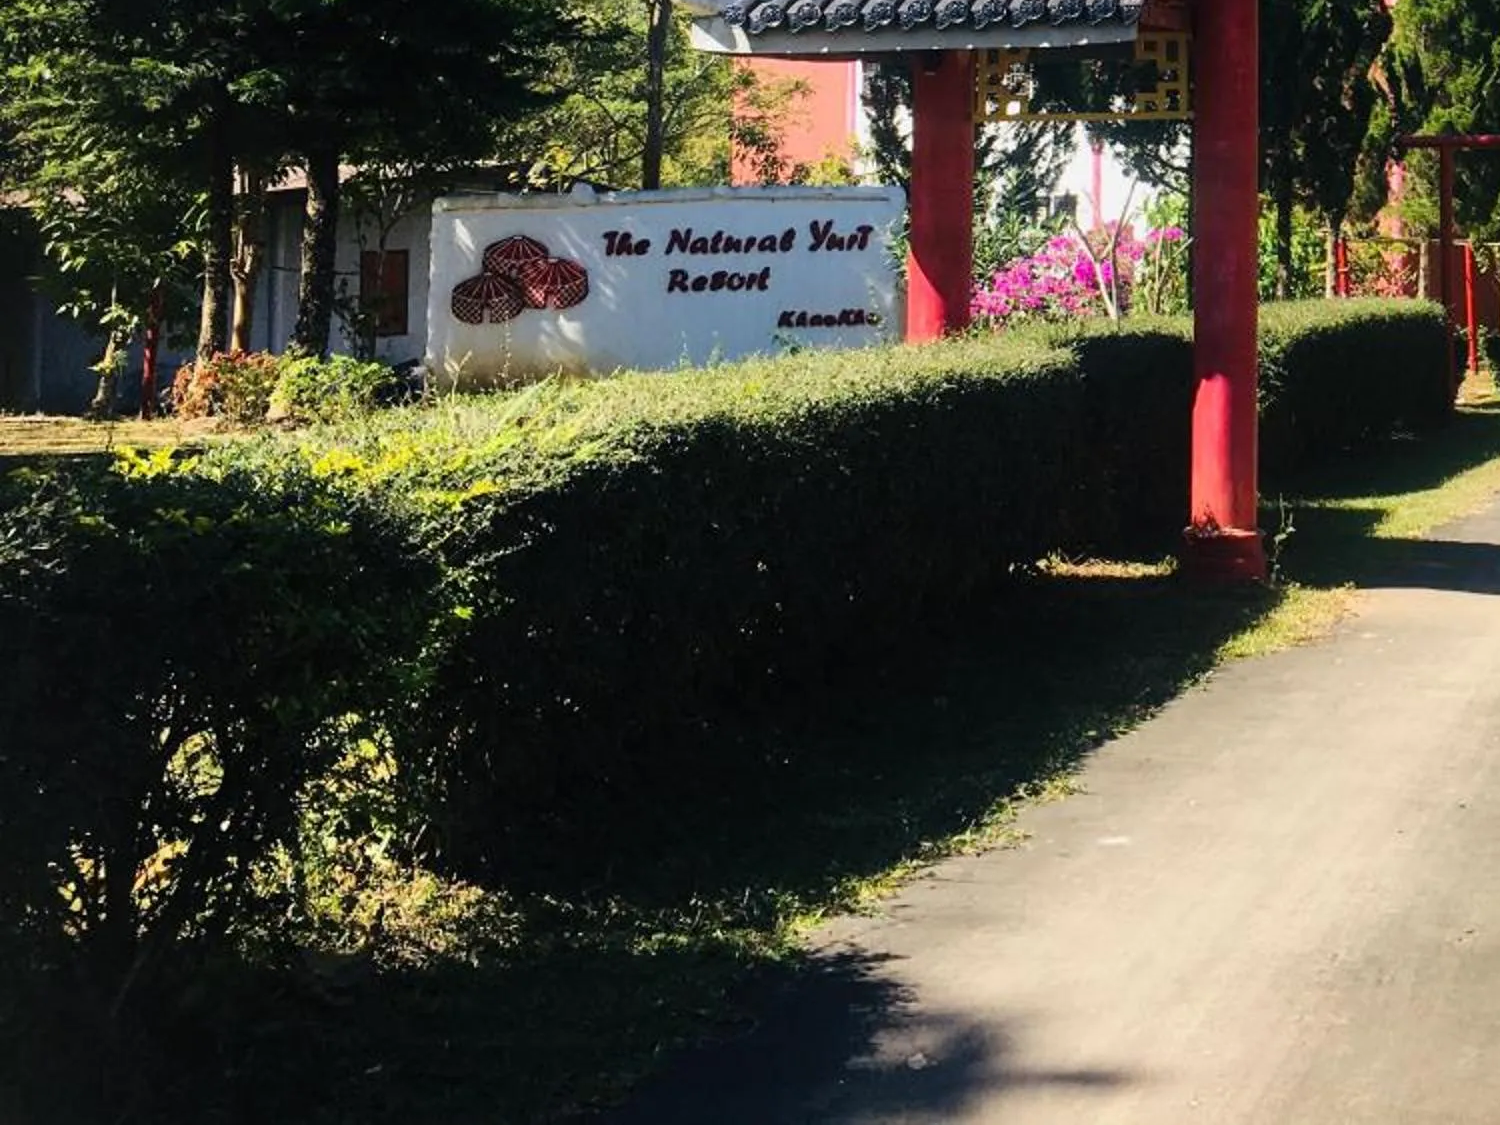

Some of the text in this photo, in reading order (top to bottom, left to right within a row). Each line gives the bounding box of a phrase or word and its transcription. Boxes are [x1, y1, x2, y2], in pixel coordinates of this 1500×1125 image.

[602, 230, 651, 256] The
[664, 227, 796, 255] Natural
[667, 266, 771, 294] Resort
